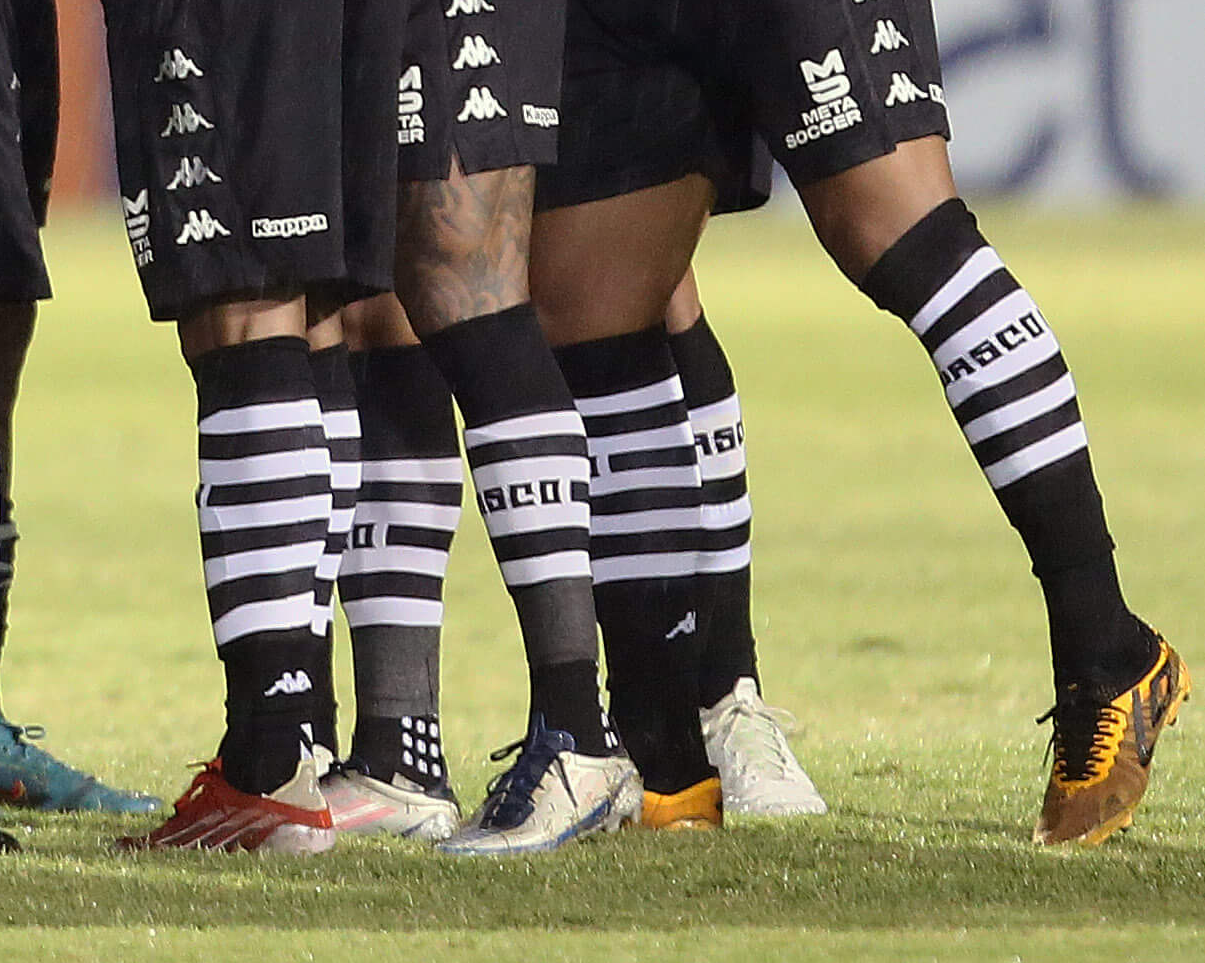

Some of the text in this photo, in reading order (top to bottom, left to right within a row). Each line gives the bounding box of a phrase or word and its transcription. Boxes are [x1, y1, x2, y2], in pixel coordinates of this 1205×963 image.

[800, 96, 859, 126] META
[784, 108, 864, 149] SOCCER
[252, 214, 328, 238] Kappa
